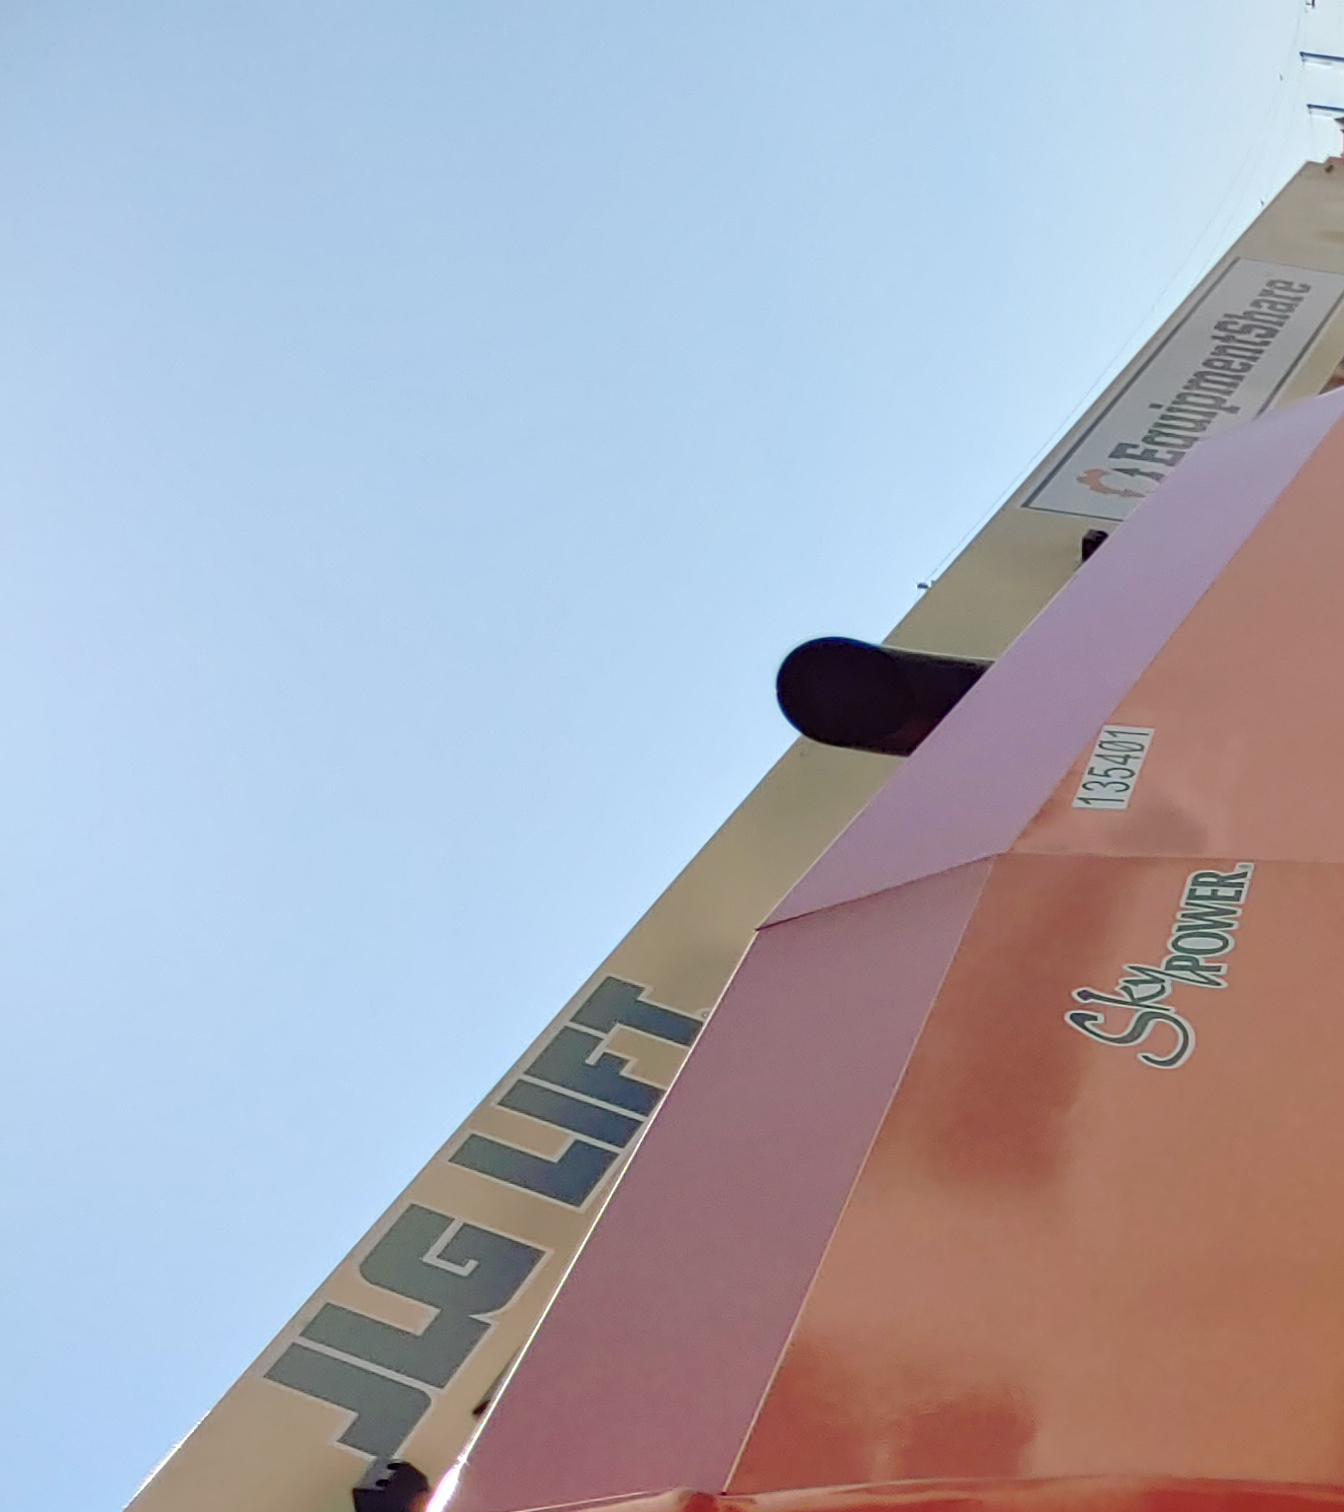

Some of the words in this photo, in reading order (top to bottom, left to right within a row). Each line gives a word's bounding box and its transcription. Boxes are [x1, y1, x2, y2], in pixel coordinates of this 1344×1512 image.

[1107, 279, 1312, 466] EquipmentShare
[1076, 730, 1149, 805] 135401
[1069, 965, 1222, 1067] Sky
[1165, 871, 1247, 972] POWER
[263, 1203, 551, 1459] JLG
[448, 975, 704, 1209] LIFT
